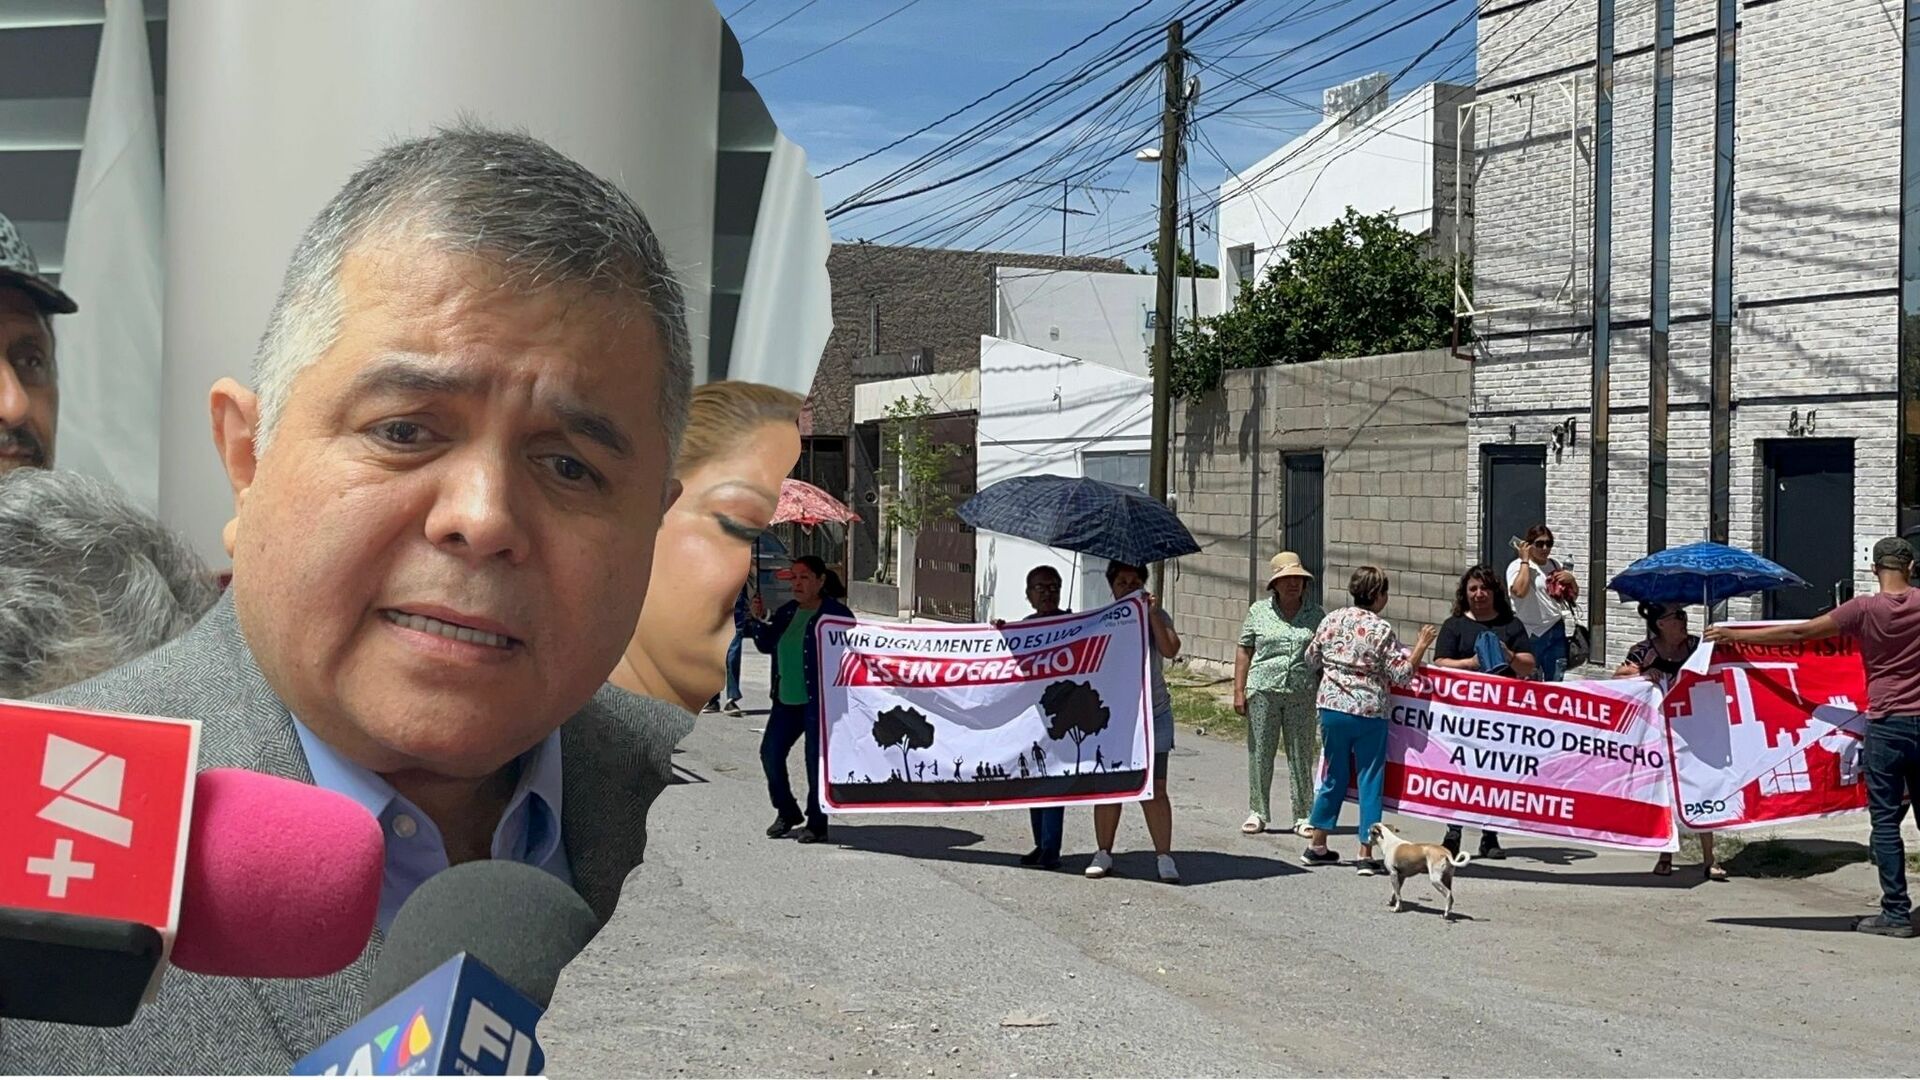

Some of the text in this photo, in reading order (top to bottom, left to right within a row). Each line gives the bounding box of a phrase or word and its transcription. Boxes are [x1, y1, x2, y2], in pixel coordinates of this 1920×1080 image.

[828, 630, 871, 648] VIVIR
[874, 635, 993, 653] DIGNAMENTE
[995, 636, 1021, 651] NO
[1023, 634, 1044, 649] ES
[864, 648, 1075, 684] ES UN DERECHO
[1506, 687, 1538, 711] LA
[1543, 692, 1612, 726] CALLE
[1440, 714, 1555, 749] NUESTRO
[1561, 732, 1664, 769] DERECHO
[1449, 746, 1540, 777] A VIVIR
[1406, 773, 1575, 820] DIGNAMENTE
[1684, 799, 1726, 816] PASO
